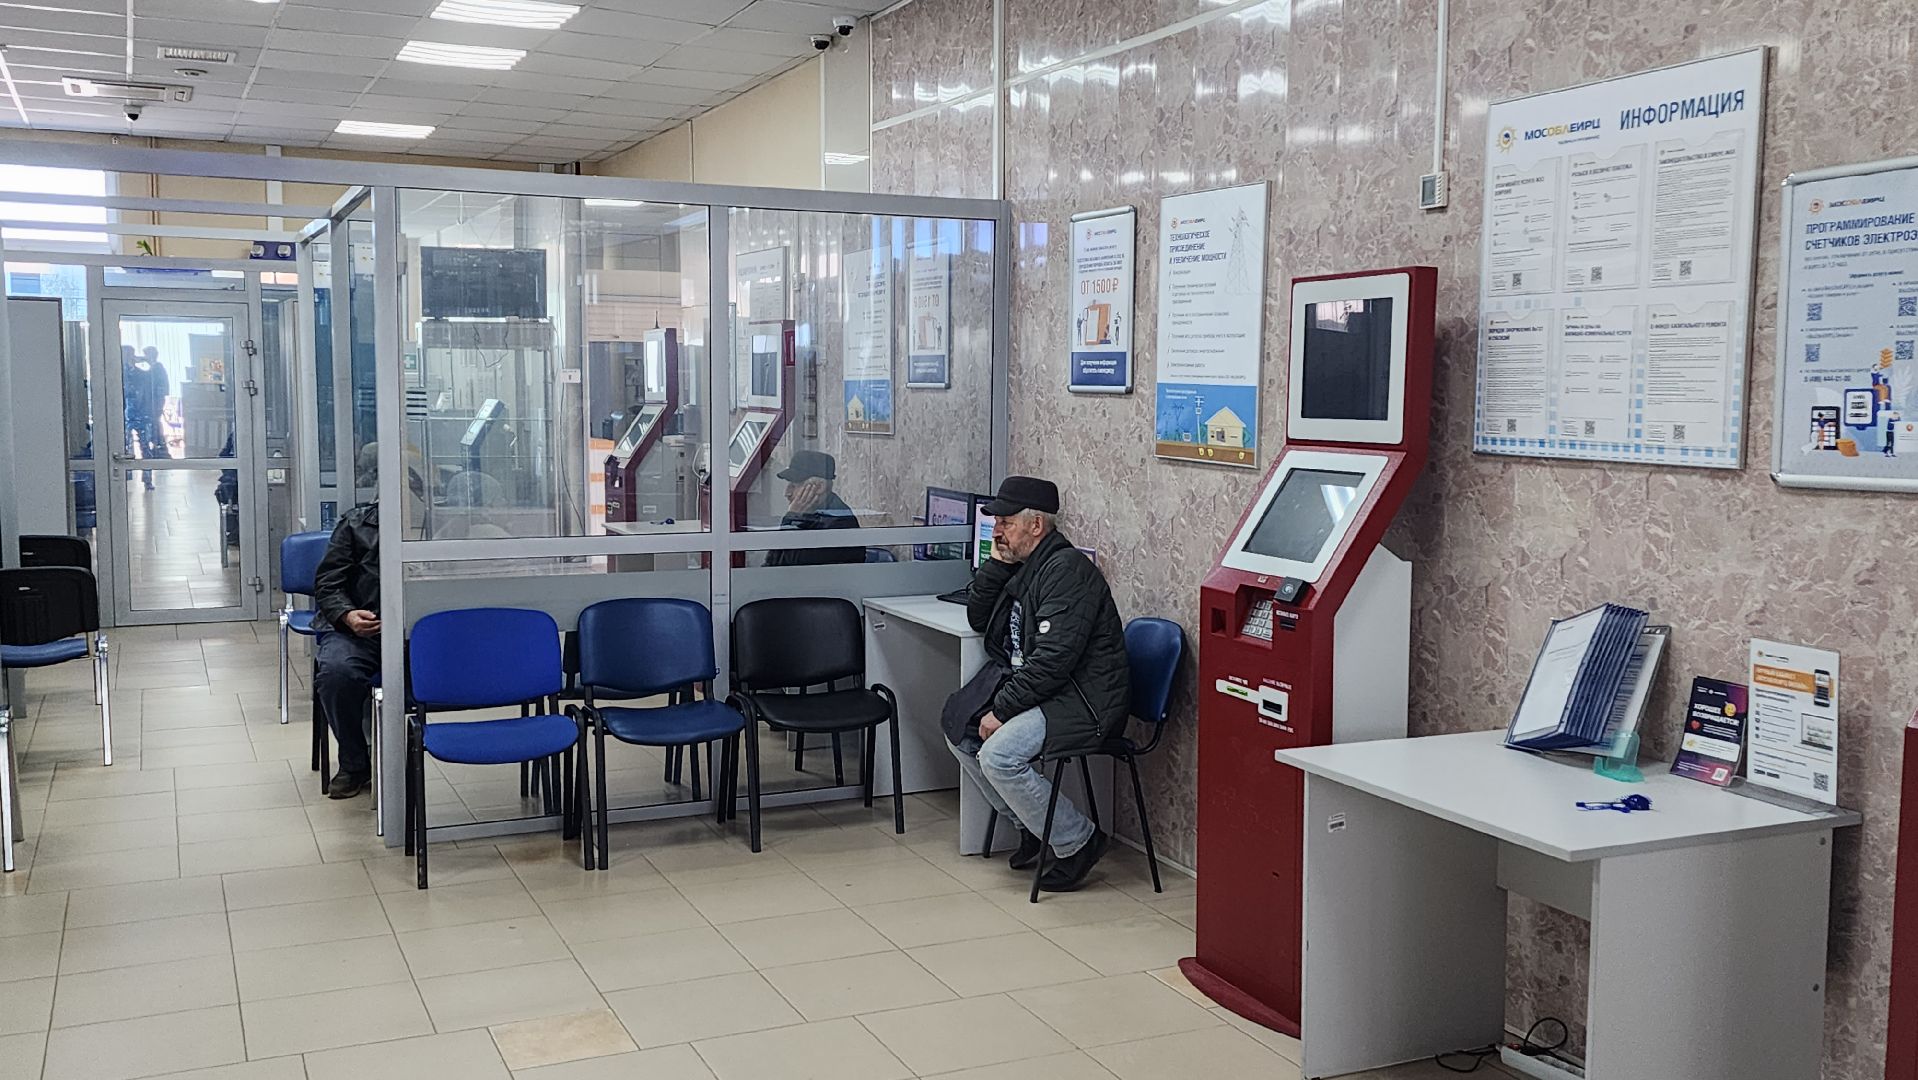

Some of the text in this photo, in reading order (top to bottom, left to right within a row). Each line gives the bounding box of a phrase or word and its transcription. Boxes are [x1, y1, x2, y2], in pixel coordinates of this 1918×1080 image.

[1619, 89, 1746, 130] ИНФОРМАЦИЯ
[1524, 118, 1600, 141] МОСОБЛЕИРЦ
[1805, 212, 1916, 235] ПРОГРАММИРОВАНИЕ
[1804, 235, 1860, 251] СЧЕТЧИКОВ
[1081, 280, 1090, 295] ОТ
[1092, 278, 1111, 294] 1500
